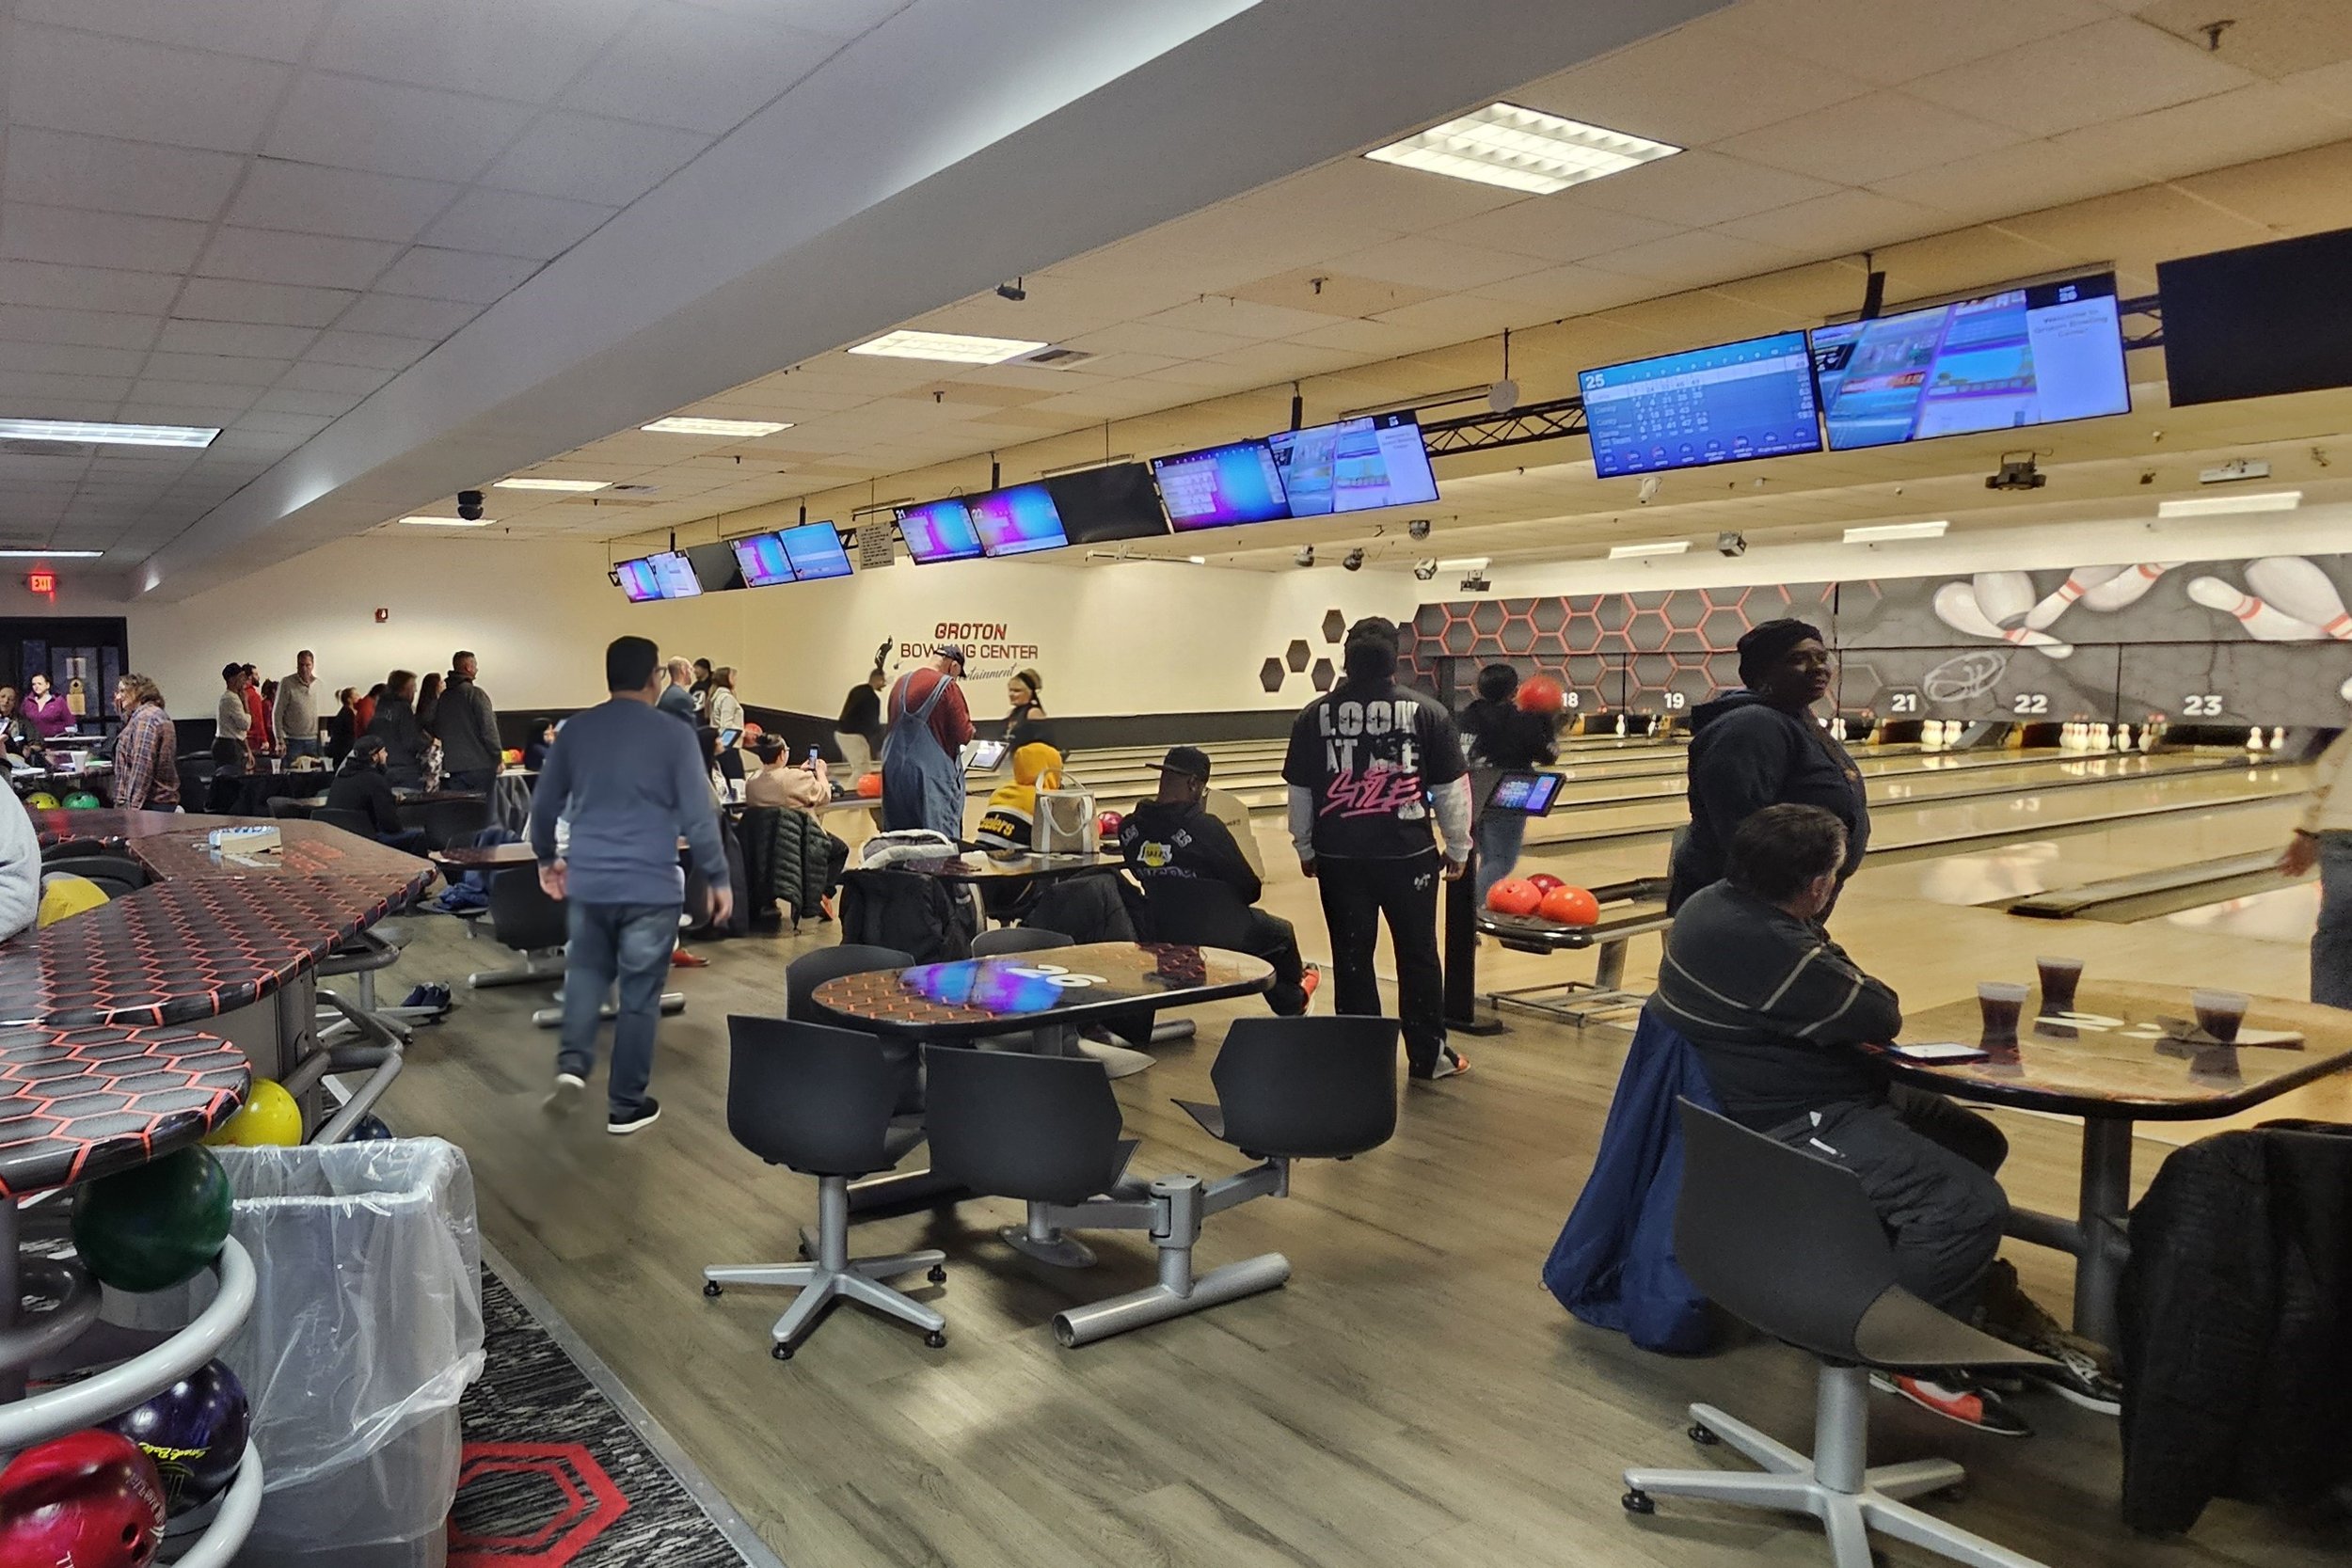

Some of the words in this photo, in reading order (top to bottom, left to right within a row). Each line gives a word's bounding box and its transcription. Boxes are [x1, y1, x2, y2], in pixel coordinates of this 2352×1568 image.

[1584, 373, 1605, 388] 25
[31, 575, 54, 592] EXIT
[934, 623, 1008, 641] GROTON
[900, 642, 977, 658] BOWNG
[980, 644, 1039, 659] CENTER
[1561, 692, 1579, 707] 18
[1663, 692, 1685, 709] 19
[1891, 693, 1917, 712] 21
[2013, 694, 2048, 713] 22
[2183, 695, 2222, 716] 23
[1319, 700, 1420, 736] LOOK
[979, 814, 1015, 836] eelers
[1005, 964, 1108, 988] 26
